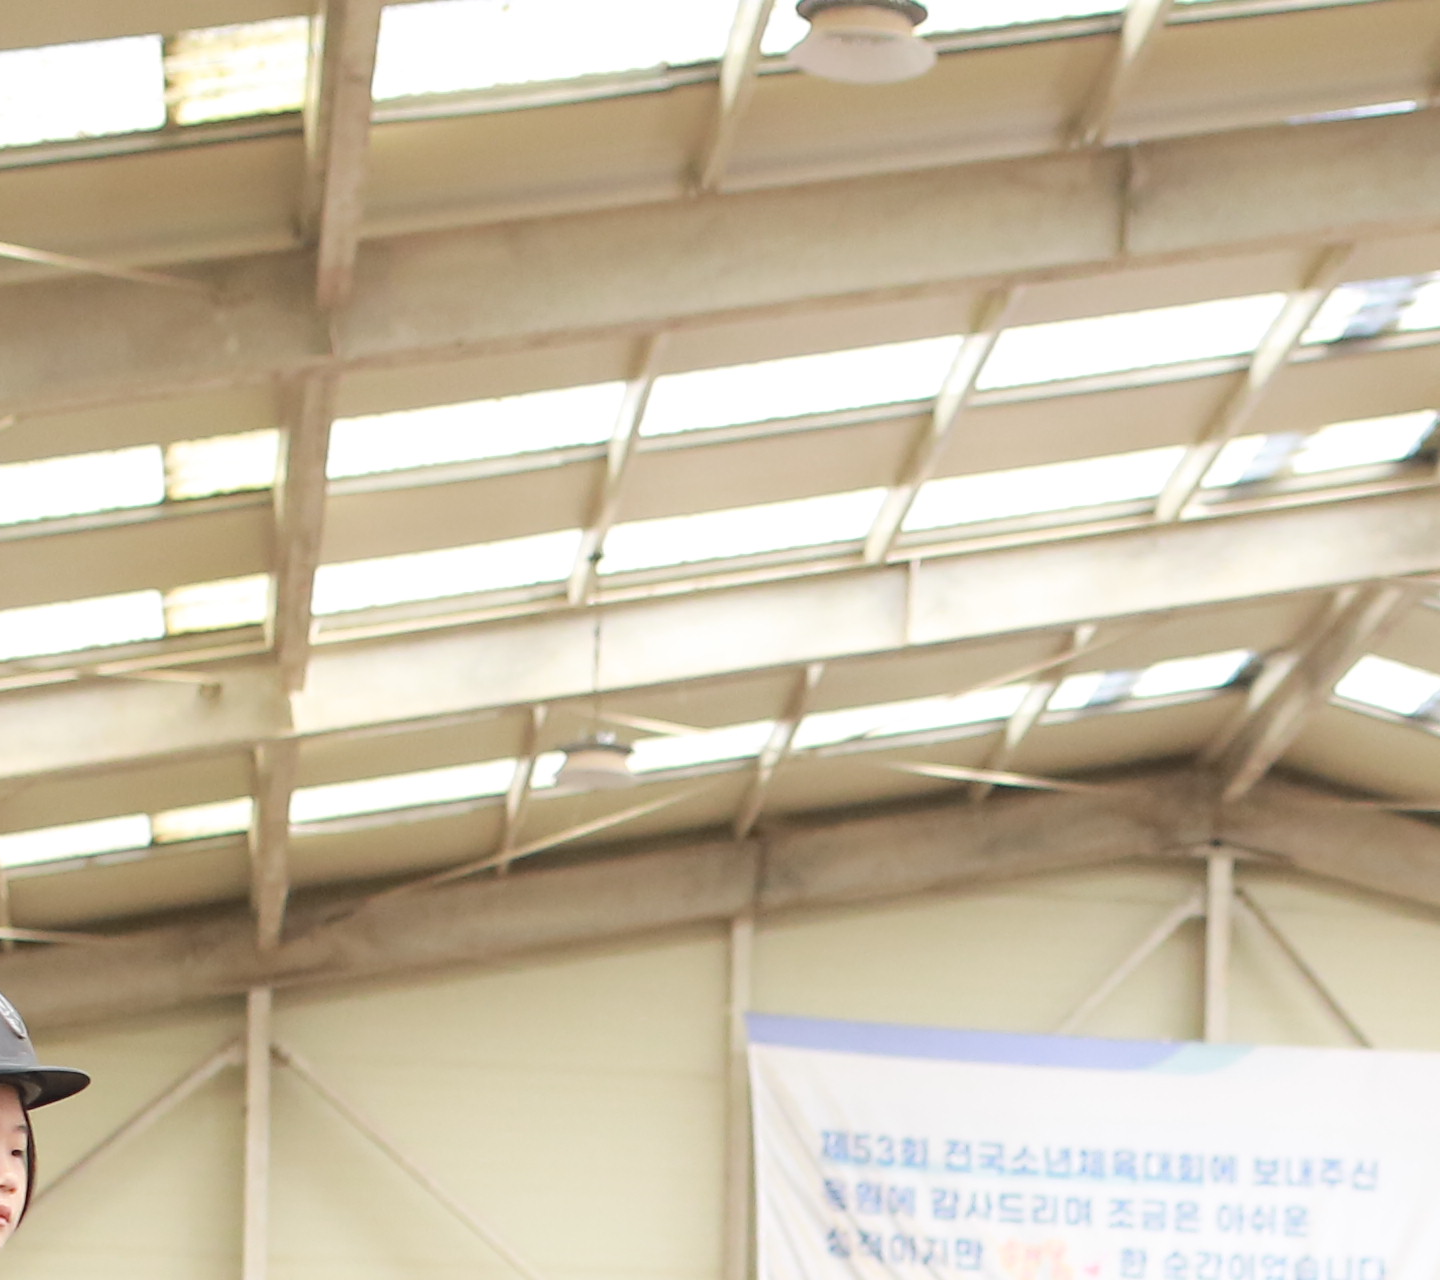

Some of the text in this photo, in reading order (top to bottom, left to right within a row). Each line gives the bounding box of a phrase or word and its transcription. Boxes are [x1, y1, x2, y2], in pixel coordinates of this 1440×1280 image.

[822, 1130, 1380, 1191] 제53회 전국소년체육대회에 보내주신
[932, 1186, 1094, 1228] 감사드리며
[1108, 1197, 1201, 1234] 조금은
[1216, 1202, 1310, 1238] 아쉬운
[1119, 1246, 1148, 1280] 한
